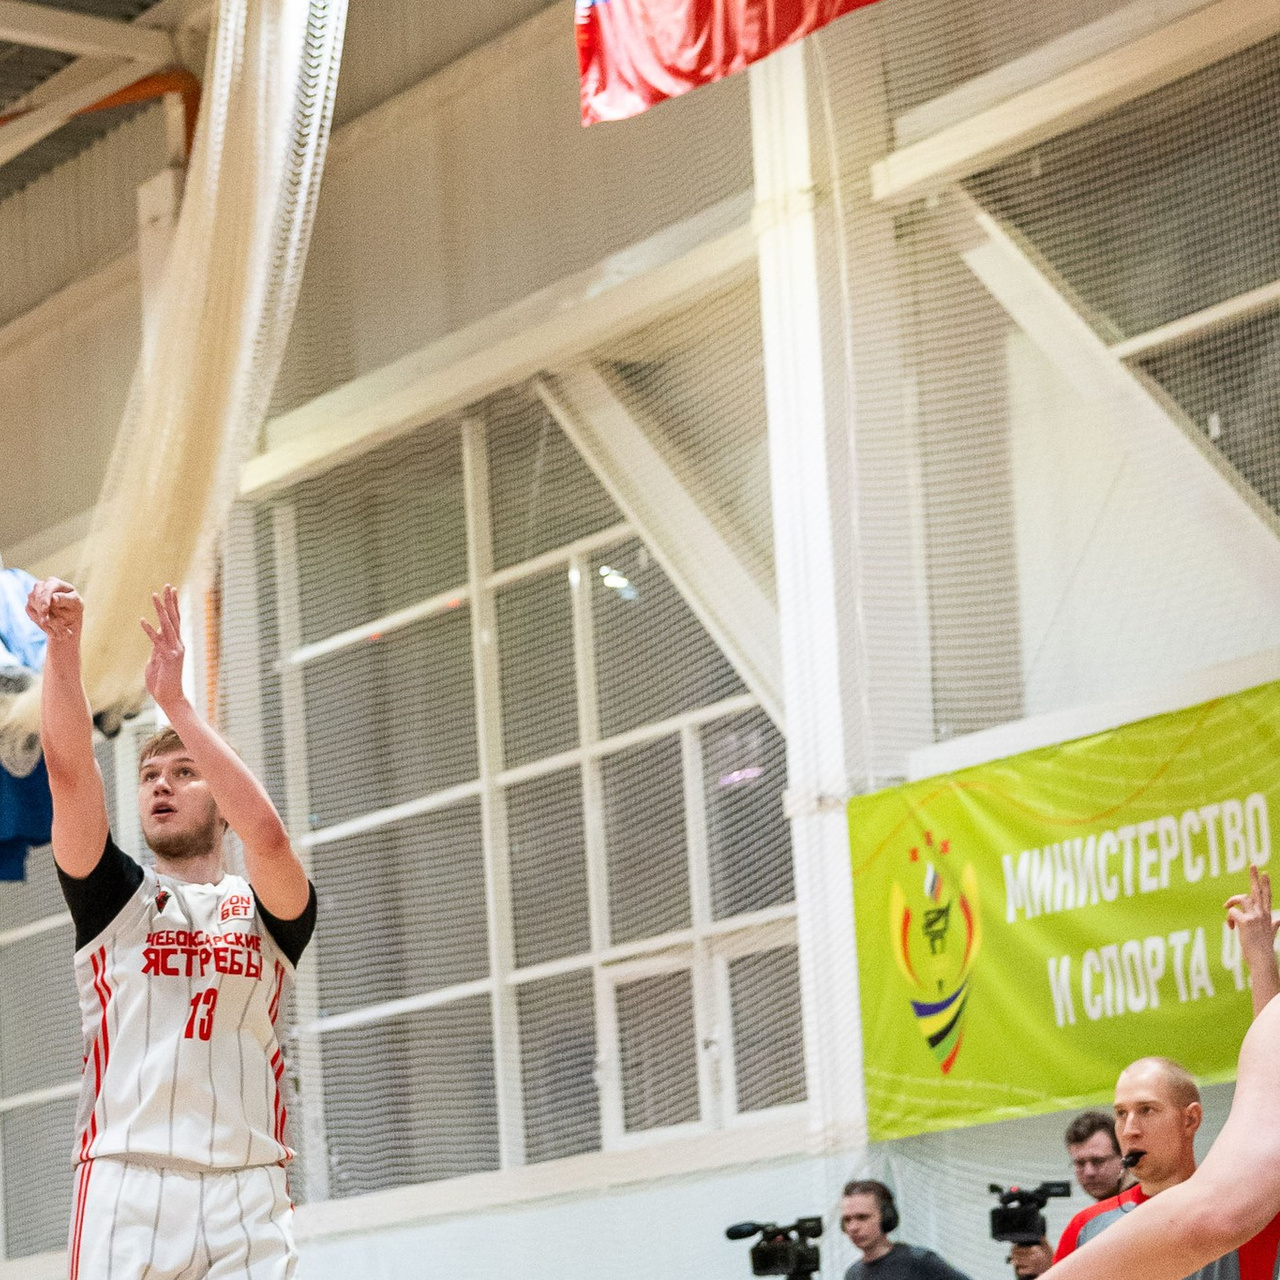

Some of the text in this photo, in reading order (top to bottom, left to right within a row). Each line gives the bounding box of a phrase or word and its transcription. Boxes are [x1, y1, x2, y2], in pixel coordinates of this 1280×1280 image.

[1002, 792, 1272, 923] МИНИСТЕРСТВО
[221, 906, 251, 921] BET
[146, 929, 262, 953] ЧЕБОКСАРСКИЕ
[141, 947, 263, 981] ЯСТРЕБЫ
[1081, 927, 1216, 1022] СПОРТА
[184, 987, 218, 1041] 13
